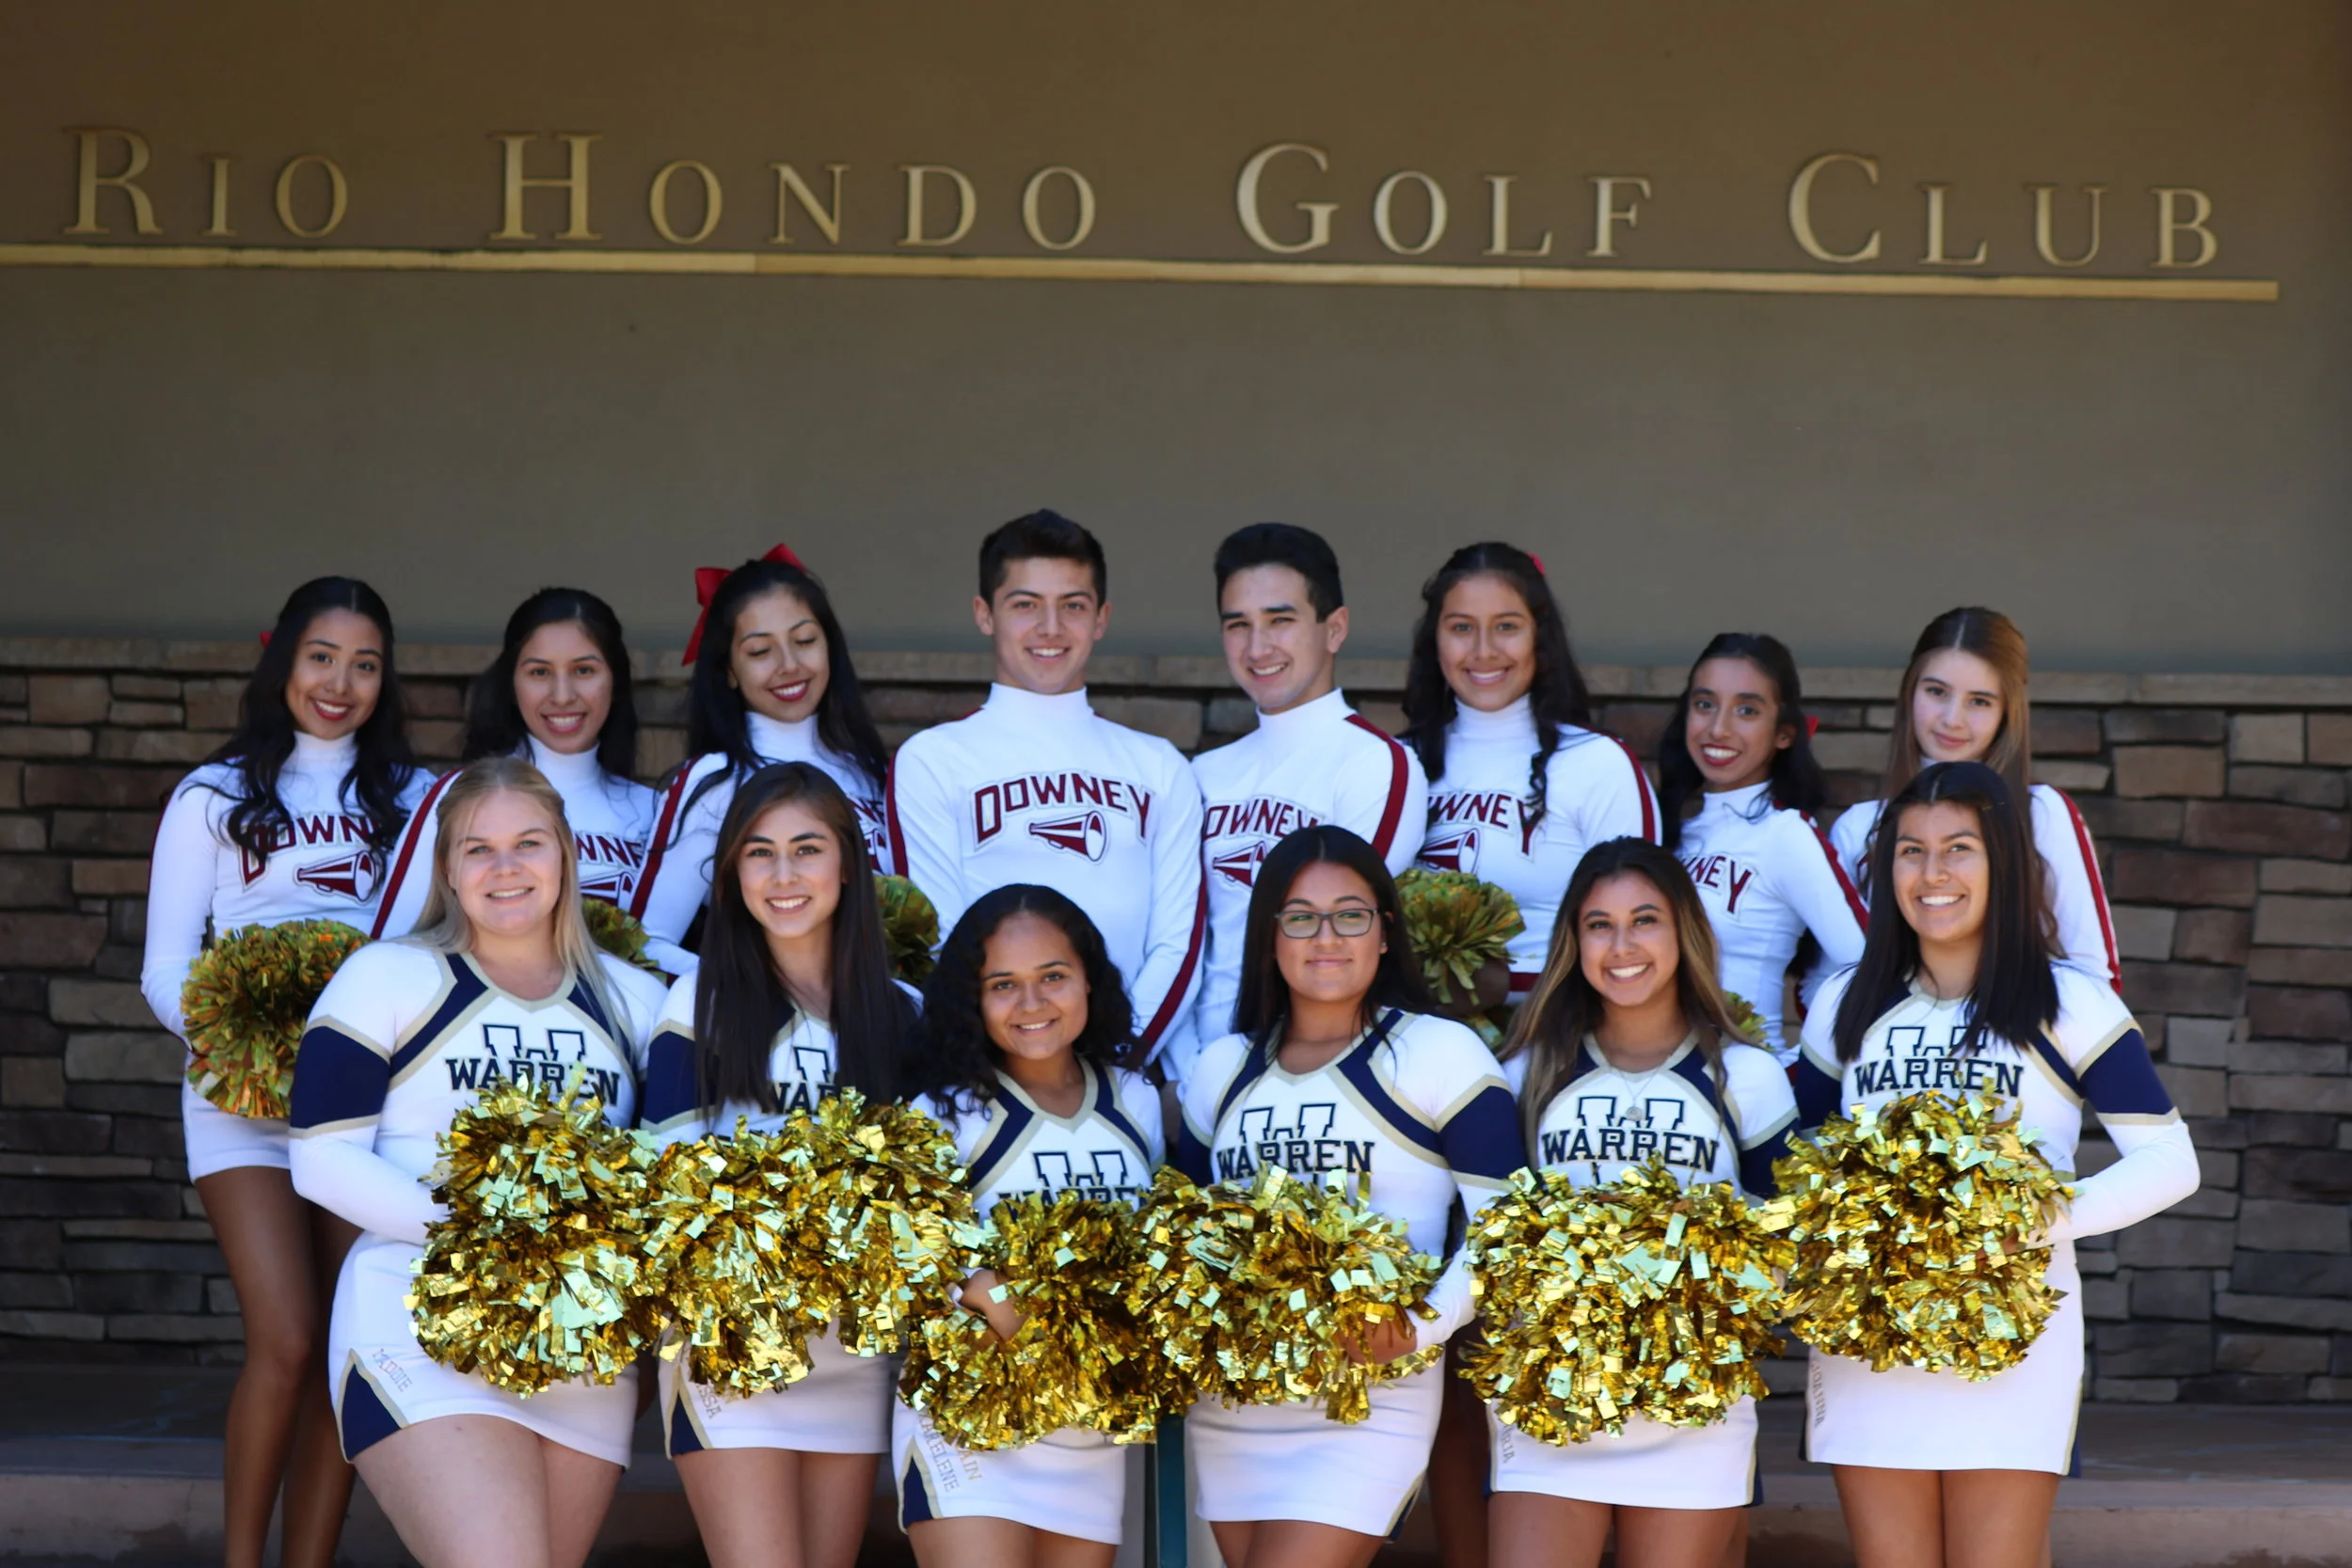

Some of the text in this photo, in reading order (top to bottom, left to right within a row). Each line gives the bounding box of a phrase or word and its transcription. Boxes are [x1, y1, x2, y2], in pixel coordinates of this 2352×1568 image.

[61, 126, 2219, 269] RIO HONDO GOLF CLUB
[973, 770, 1152, 847] DOWNEY
[1427, 792, 1544, 857] WNEY
[1854, 1058, 2025, 1098] WARREN
[1216, 1139, 1375, 1180] WARREN
[1541, 1128, 1721, 1174] WARREN
[694, 1381, 723, 1419] SSA
